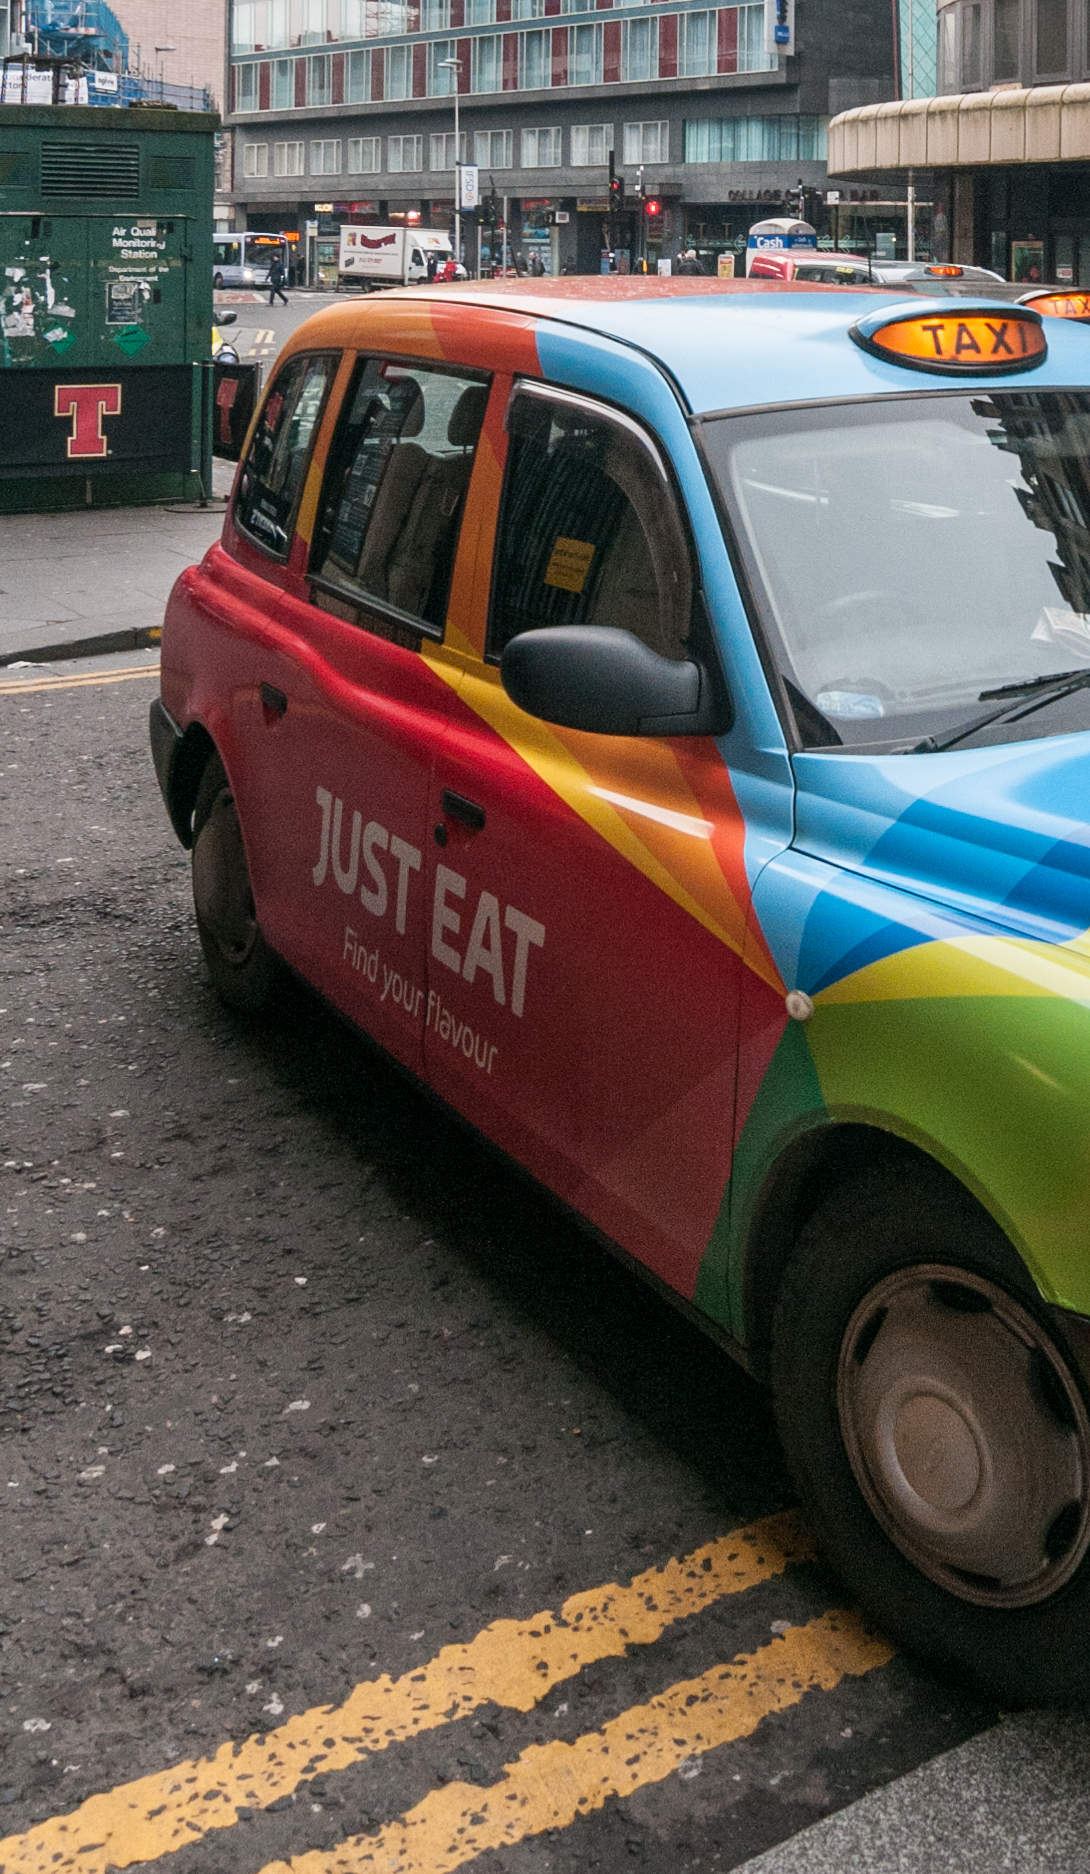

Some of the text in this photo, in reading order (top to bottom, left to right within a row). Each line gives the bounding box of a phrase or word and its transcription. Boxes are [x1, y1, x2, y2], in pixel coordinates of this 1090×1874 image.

[112, 226, 127, 236] Air
[756, 236, 784, 249] Cash
[121, 249, 158, 259] Station
[922, 322, 1029, 355] TAXI
[54, 383, 122, 459] T
[312, 785, 546, 1018] JUST EAT
[343, 926, 498, 1074] Find your flavour
